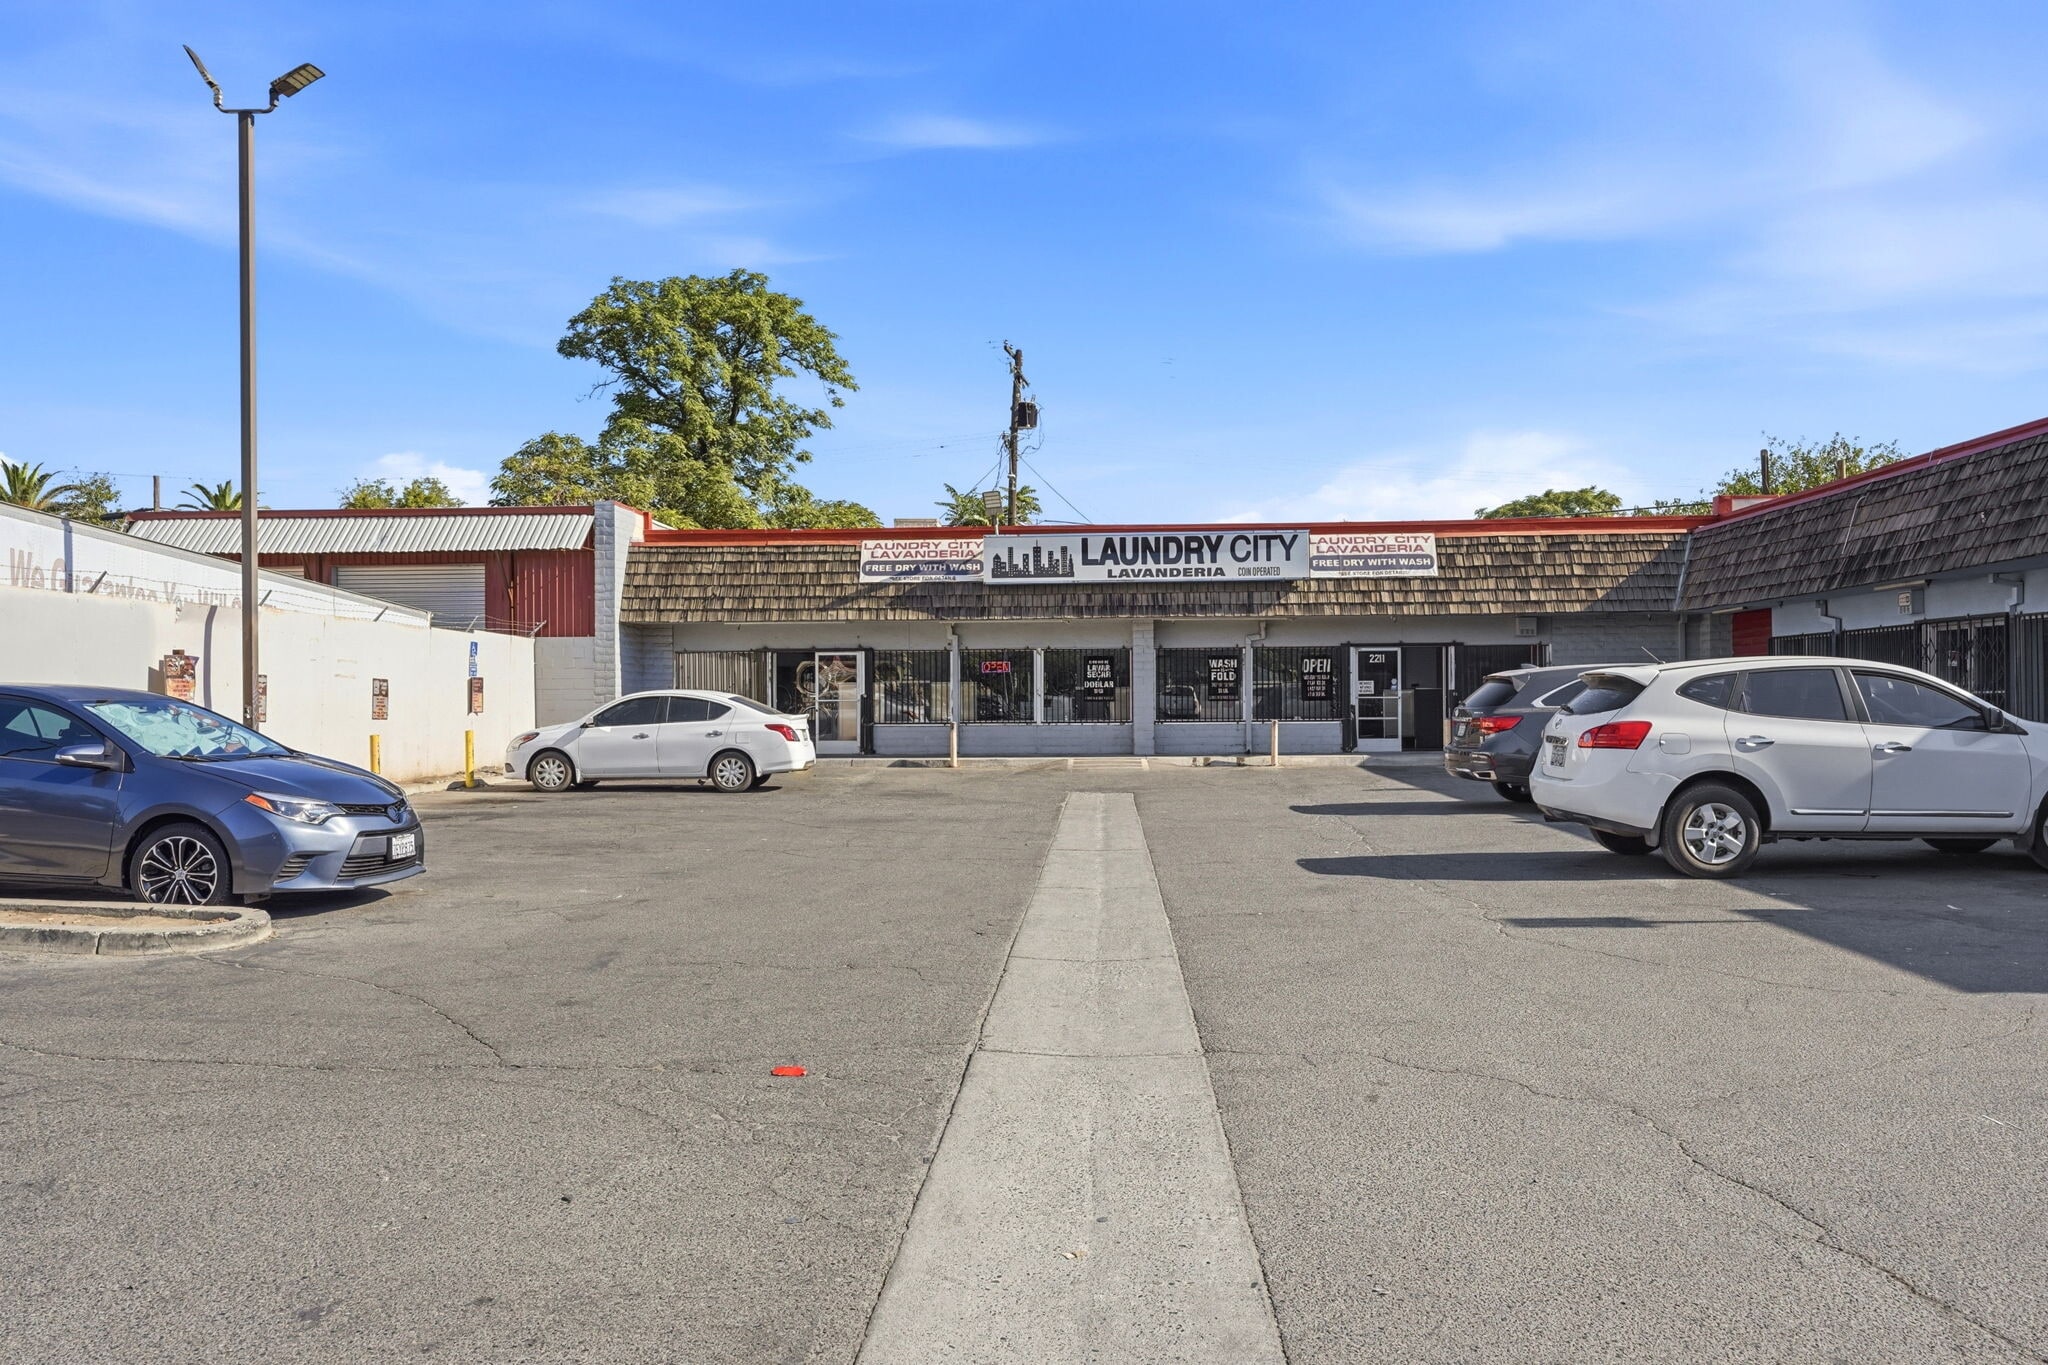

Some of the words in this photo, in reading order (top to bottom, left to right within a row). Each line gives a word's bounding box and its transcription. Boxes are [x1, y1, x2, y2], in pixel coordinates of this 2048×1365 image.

[1310, 536, 1388, 544] LAUNDRY
[1394, 536, 1432, 544] CITY
[864, 541, 942, 550] LAUNDRY
[948, 541, 984, 549] CITY
[1081, 534, 1224, 566] LAUNDRY
[1230, 534, 1298, 562] CITY
[1316, 544, 1425, 553] LAVANDERIA
[870, 550, 976, 559] LAVANDERIA
[10, 547, 45, 589] We
[1238, 567, 1251, 577] COIN
[1252, 567, 1280, 576] OPERATED
[1107, 567, 1226, 579] LAVANDERIA
[1369, 654, 1385, 663] 2211
[983, 662, 1009, 672] OPEN
[1208, 659, 1237, 668] WASH
[1302, 658, 1331, 672] OPEN
[1211, 672, 1236, 680] FOLD
